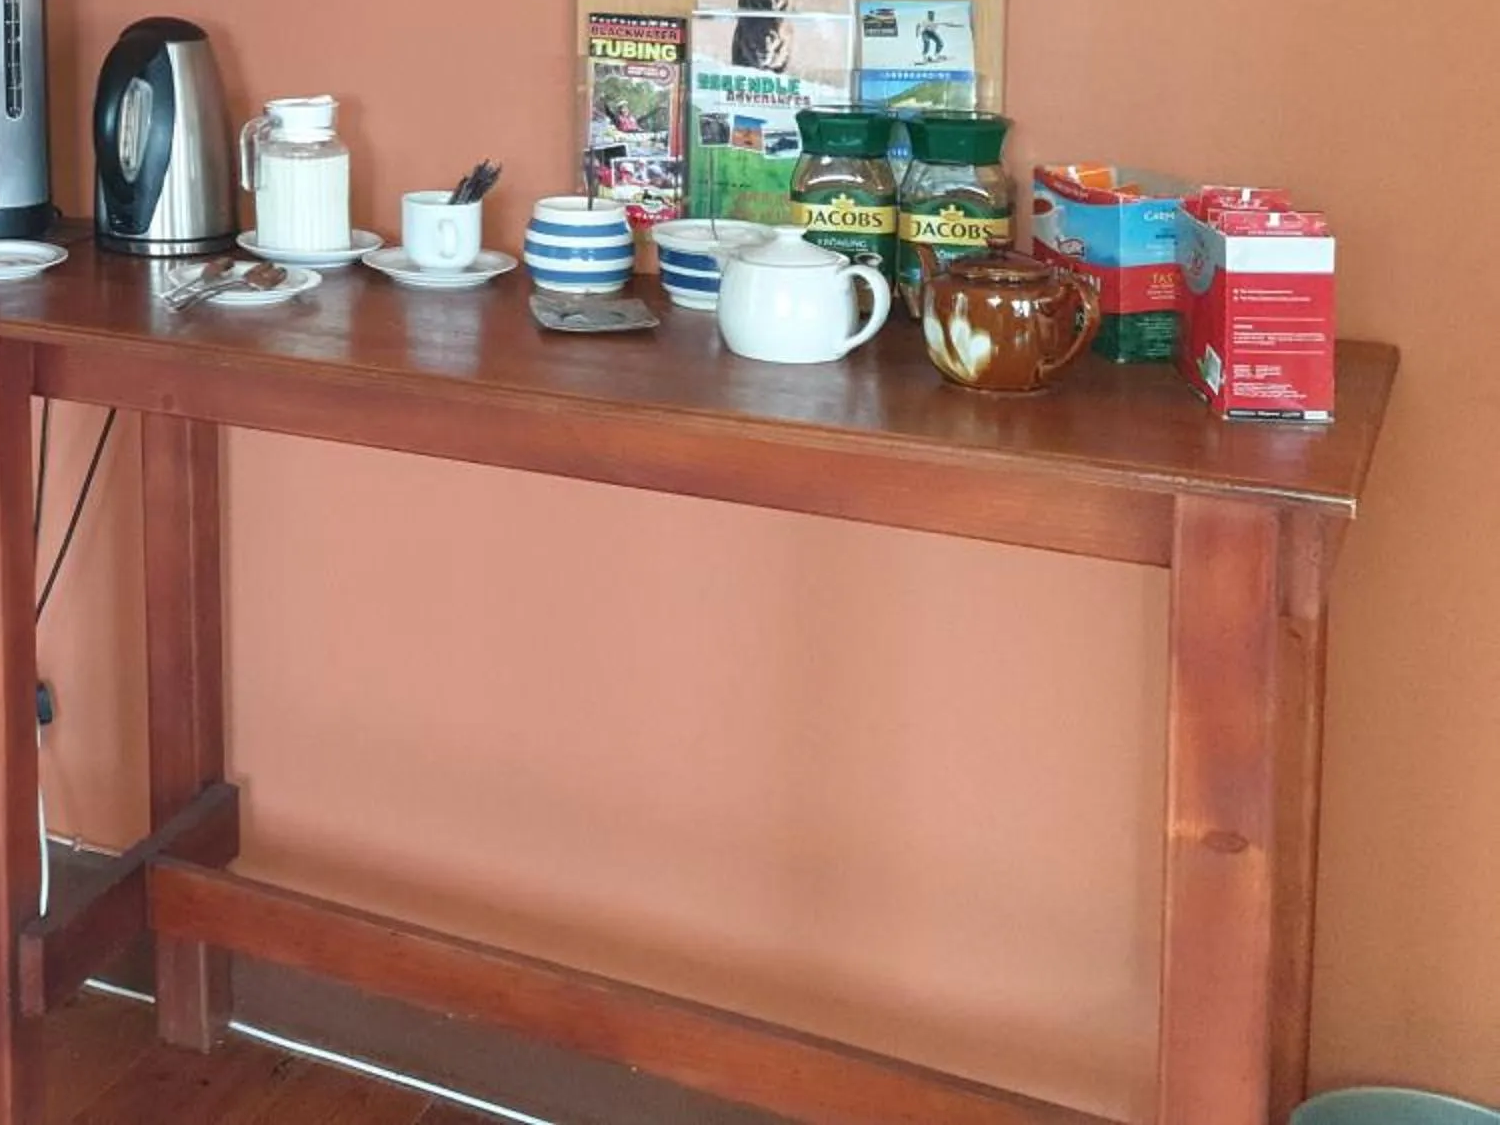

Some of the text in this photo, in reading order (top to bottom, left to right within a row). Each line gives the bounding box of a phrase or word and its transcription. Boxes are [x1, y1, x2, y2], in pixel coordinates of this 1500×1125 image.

[591, 39, 677, 61] TUBING
[806, 209, 884, 228] JACOBS
[911, 220, 995, 239] JACOBS
